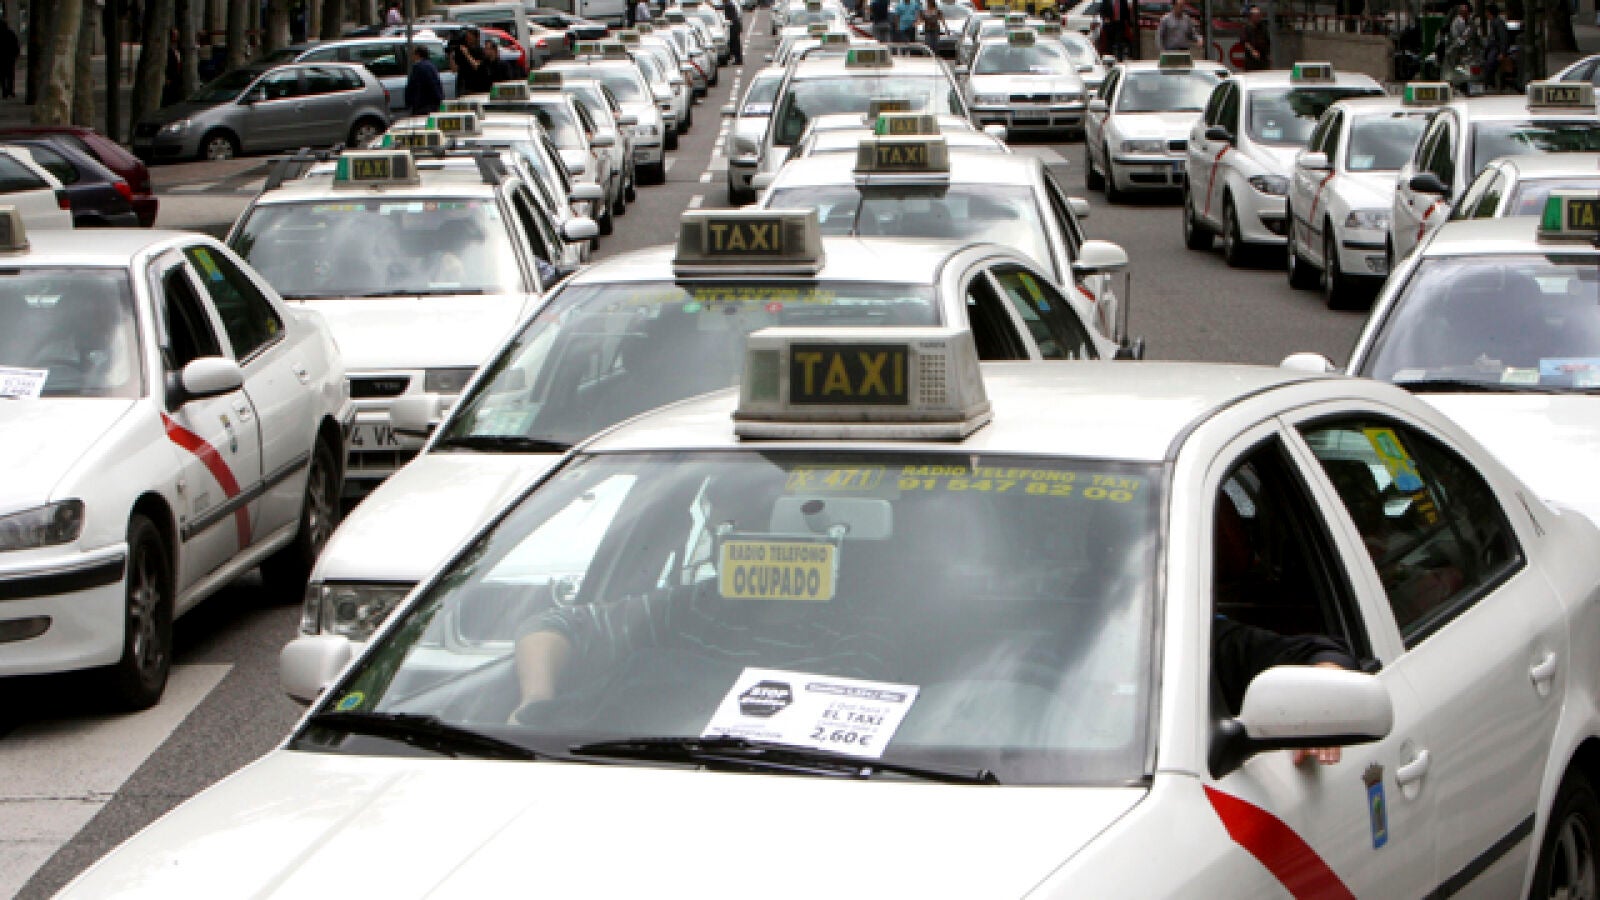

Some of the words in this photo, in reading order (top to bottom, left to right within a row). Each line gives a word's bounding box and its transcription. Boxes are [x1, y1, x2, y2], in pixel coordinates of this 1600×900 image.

[879, 146, 925, 164] TAXI
[355, 159, 390, 177] TAXI
[1571, 202, 1600, 225] TA
[710, 224, 778, 250] TAXI
[794, 351, 904, 396] TAXI
[901, 464, 967, 477] RADIO
[972, 467, 1076, 483] TELEFONO
[1091, 474, 1141, 492] TAXI
[897, 478, 935, 491] 91
[946, 478, 1017, 492] 547
[1025, 481, 1073, 498] 82
[1084, 486, 1135, 503] 00
[729, 544, 766, 561] RADIO
[769, 545, 827, 563] TELEFONO
[734, 565, 821, 596] OCUPADO
[822, 709, 839, 721] EL
[845, 711, 885, 727] TAXI
[809, 726, 874, 747] 2,60€
